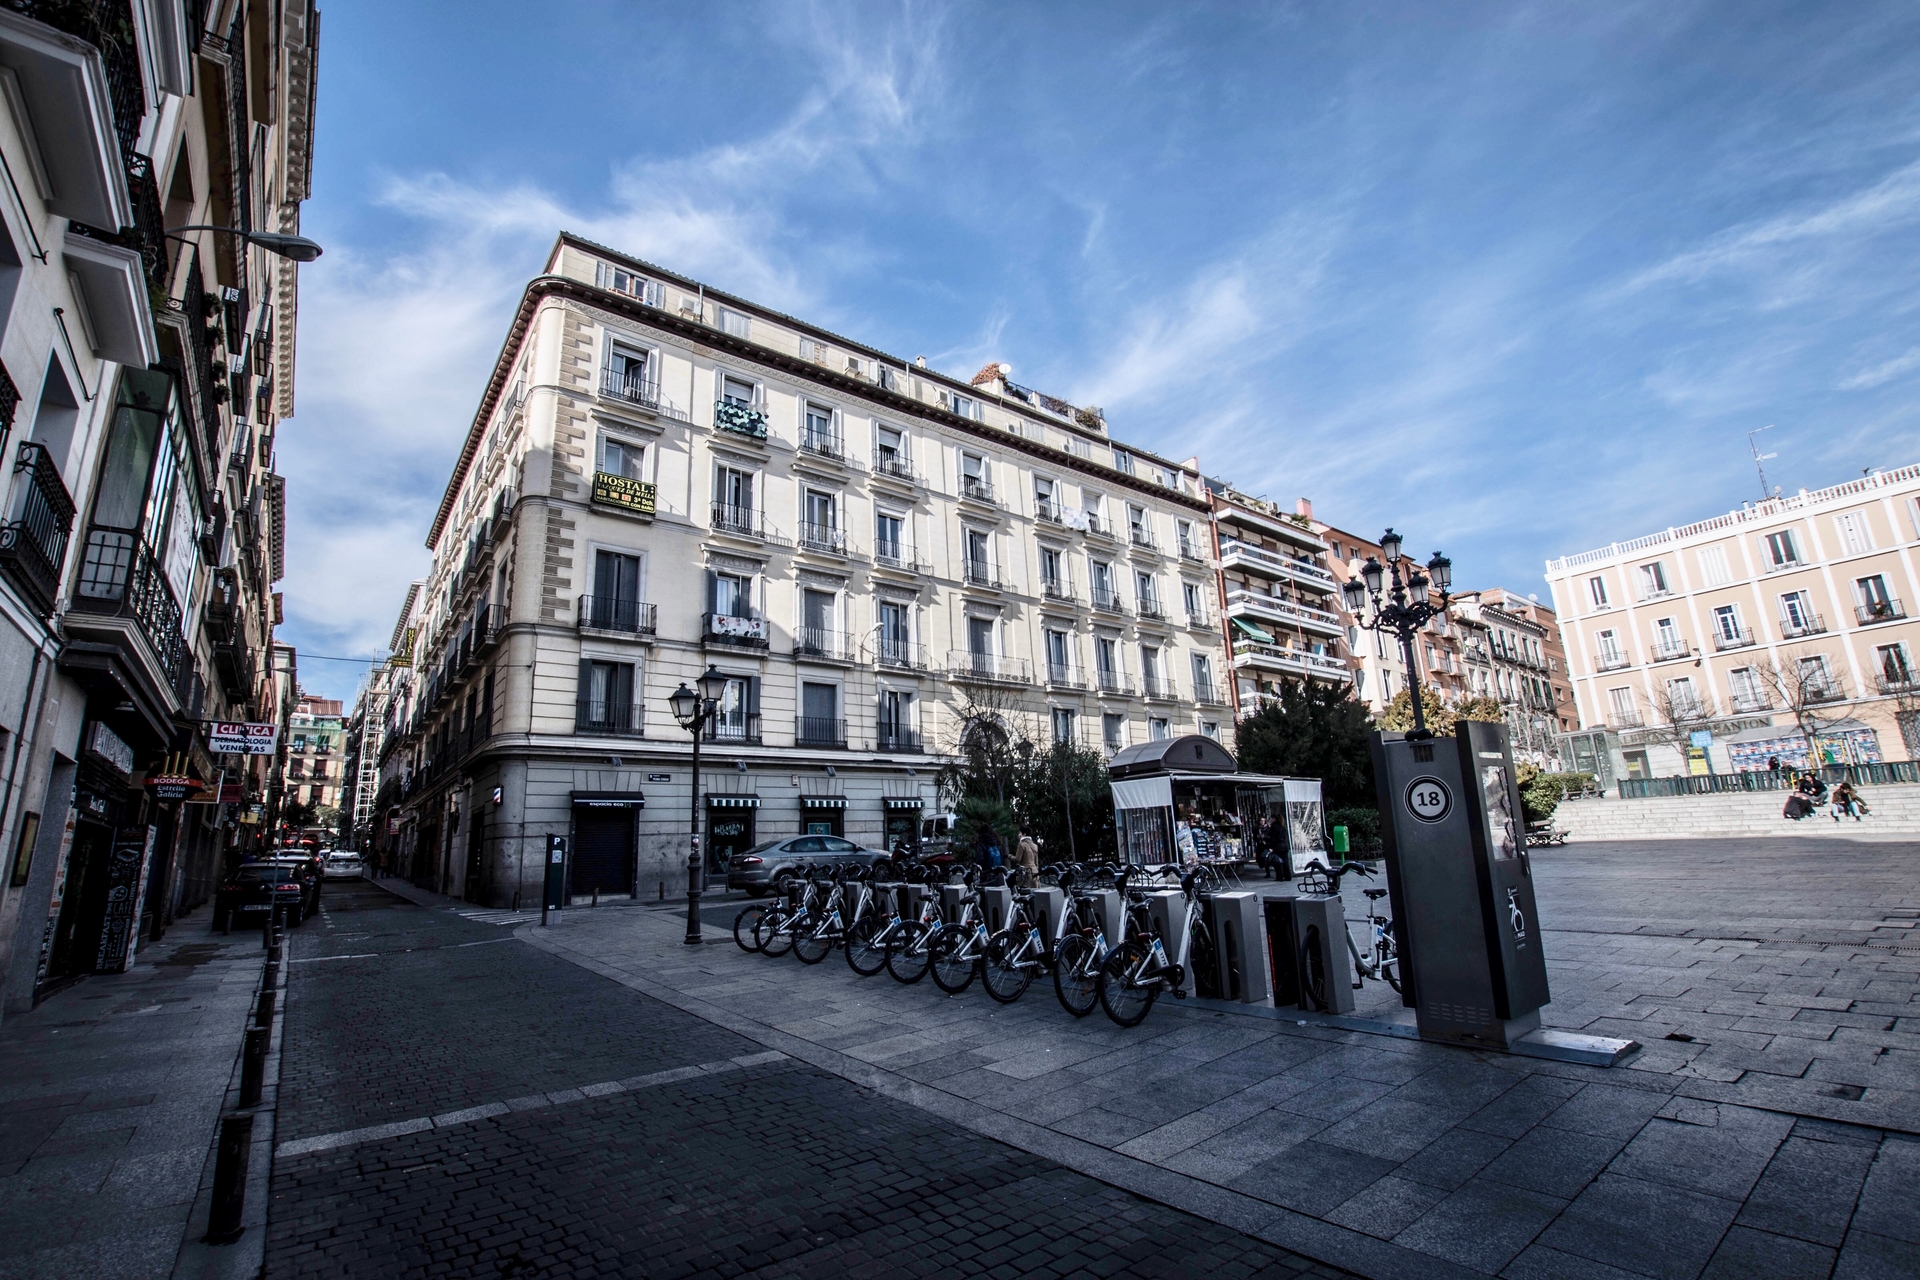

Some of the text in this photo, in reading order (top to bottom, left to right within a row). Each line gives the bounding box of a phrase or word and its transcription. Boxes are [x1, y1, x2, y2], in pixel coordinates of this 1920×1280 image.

[599, 474, 649, 493] HOSTAL
[635, 491, 654, 499] MELLA
[219, 744, 266, 752] VENEEAS
[1416, 791, 1440, 806] 18
[554, 837, 561, 845] P
